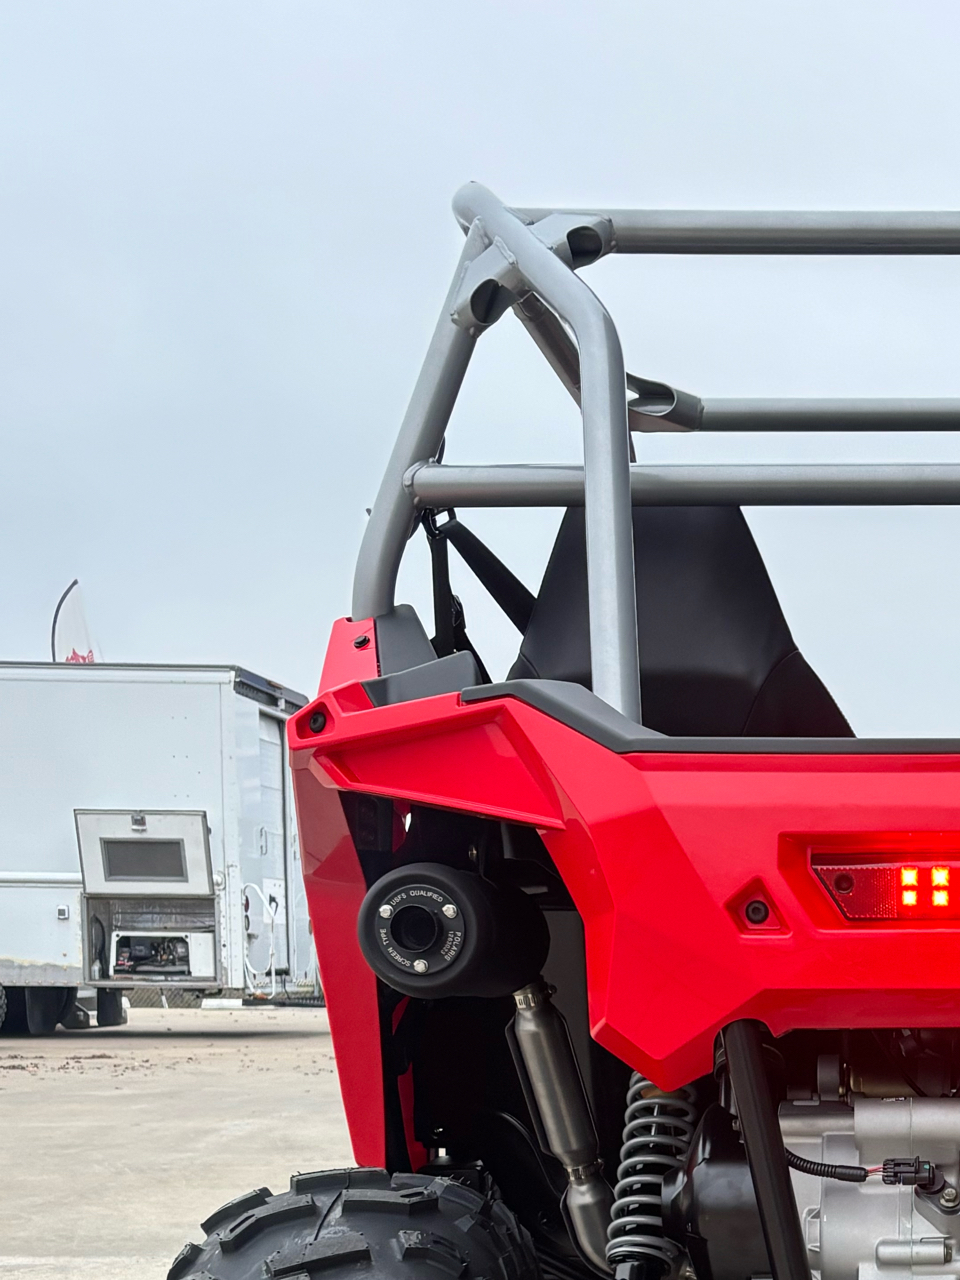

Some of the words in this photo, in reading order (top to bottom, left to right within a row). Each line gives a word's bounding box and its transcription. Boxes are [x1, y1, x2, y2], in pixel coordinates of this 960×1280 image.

[390, 893, 407, 905] USFS
[410, 890, 443, 902] QUALIFIED
[380, 929, 389, 945] TYPE
[445, 931, 461, 961] POLARIS
[387, 947, 411, 967] SCREEN
